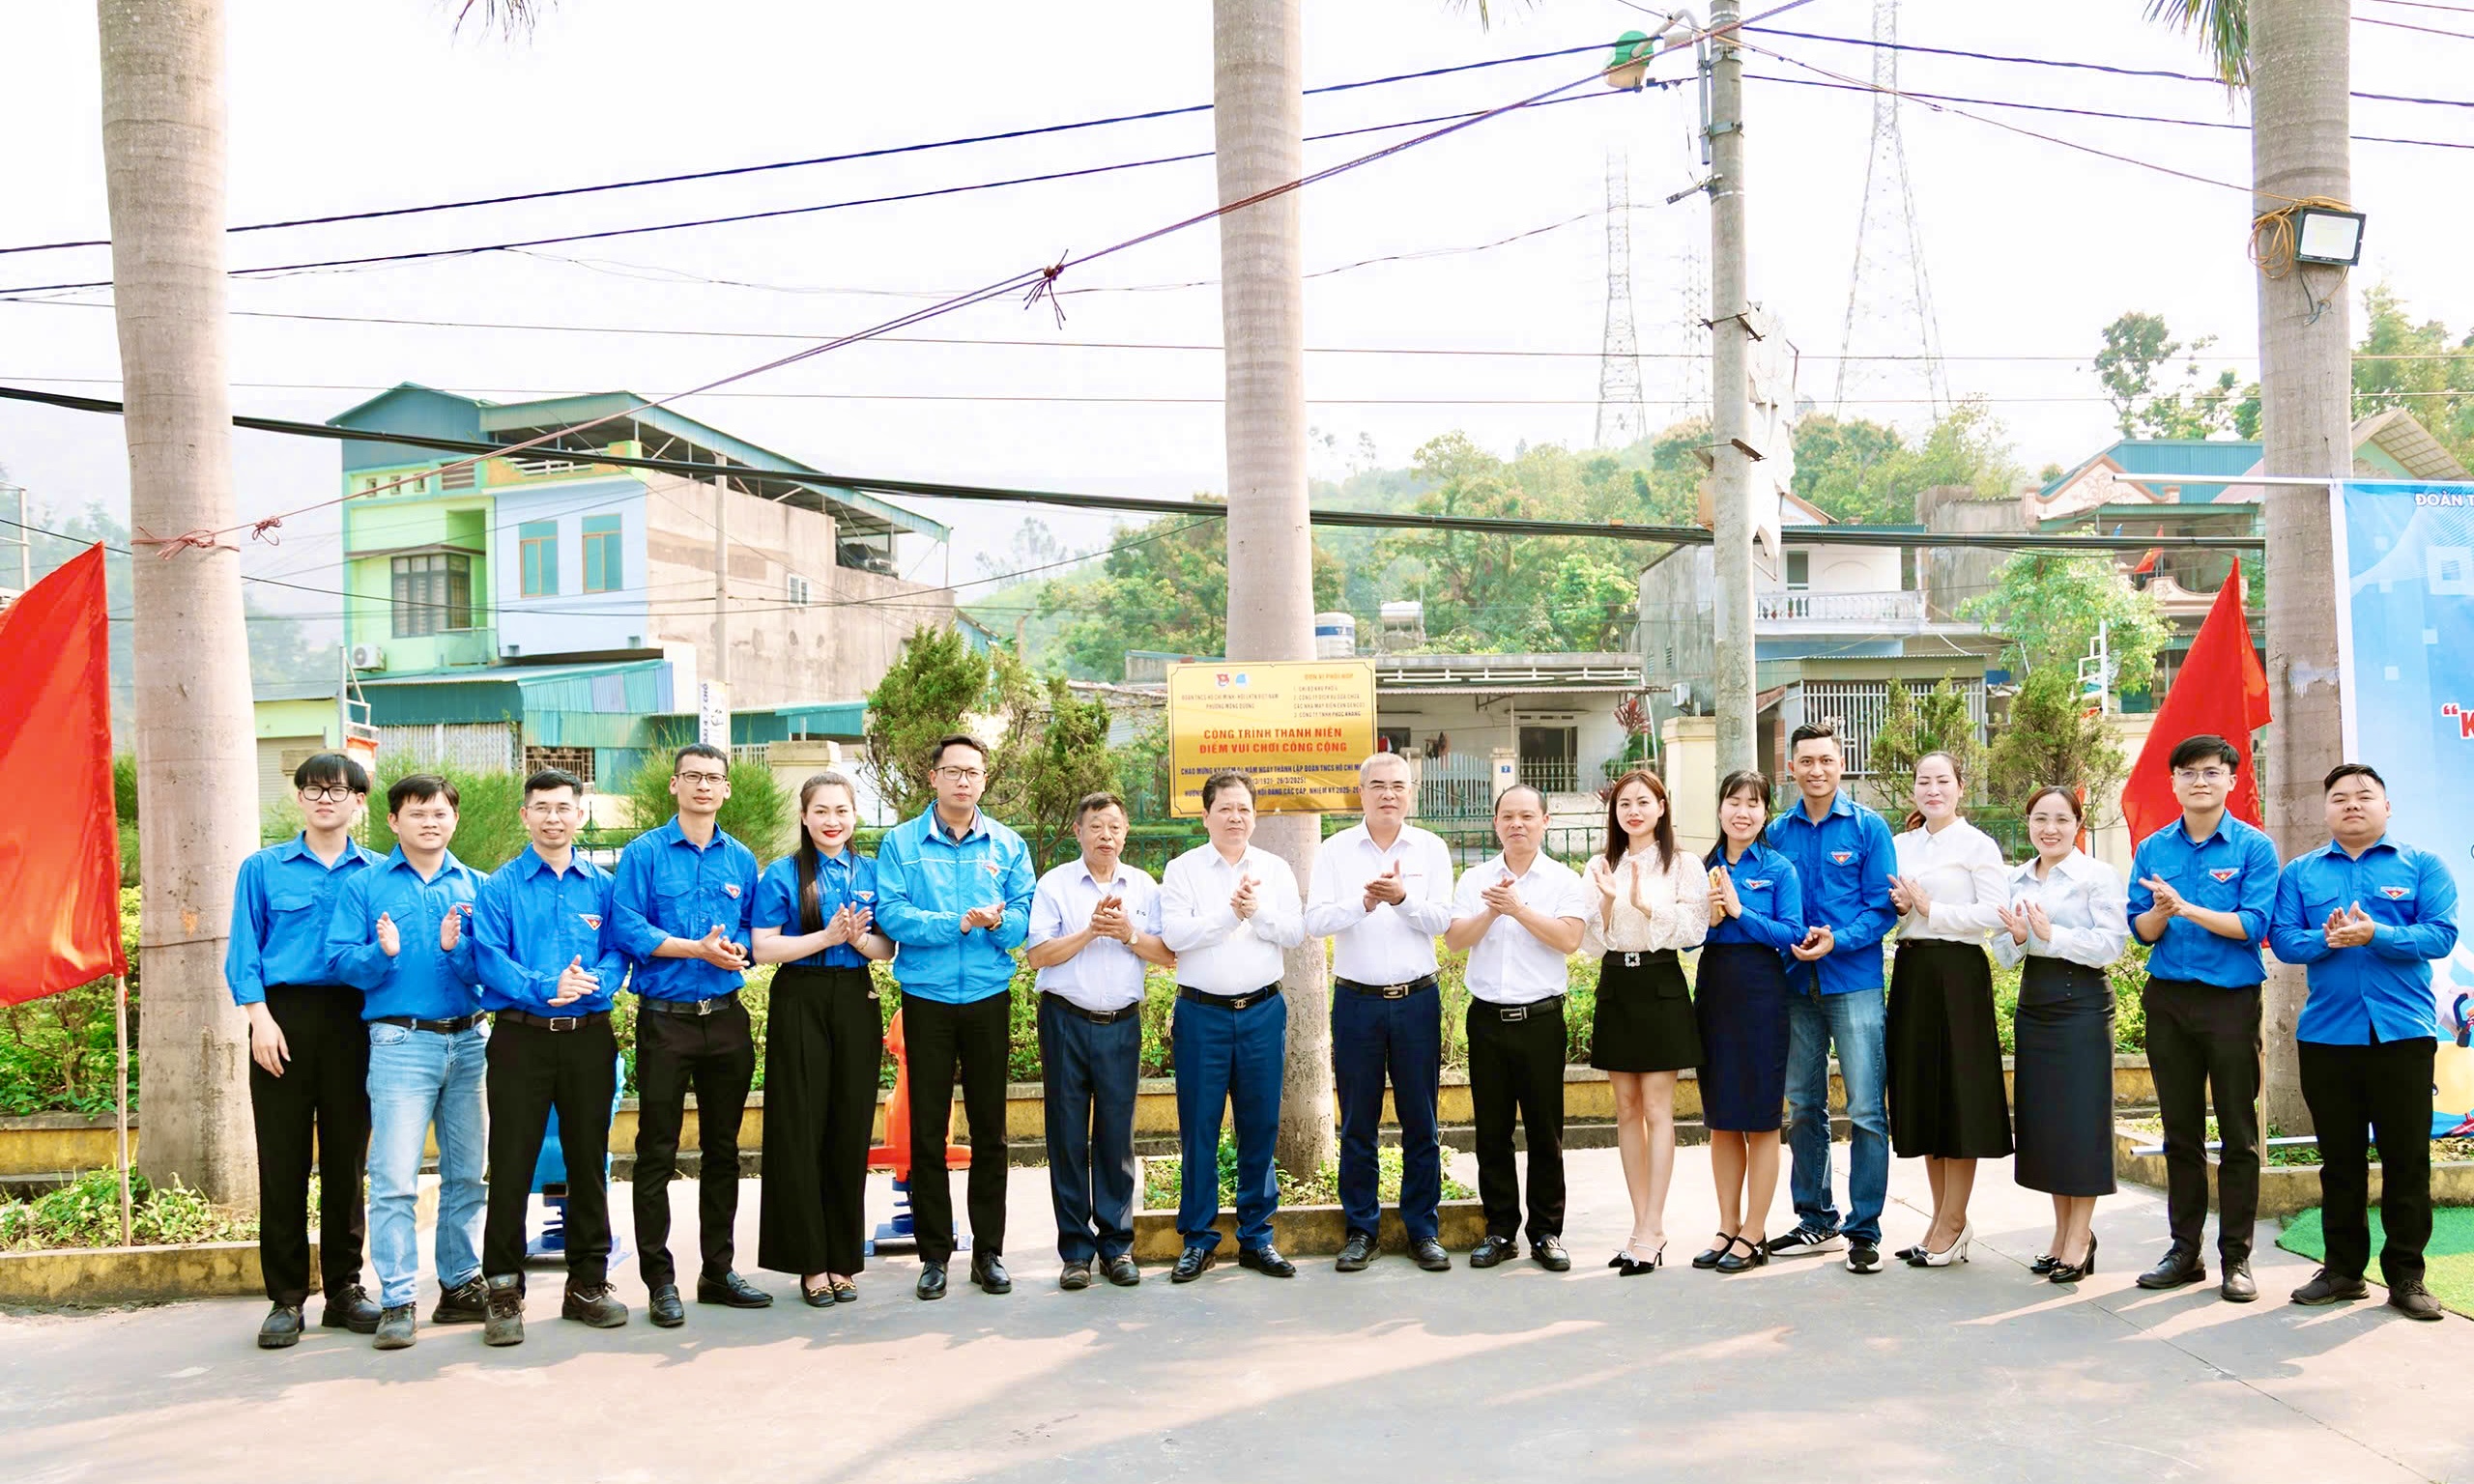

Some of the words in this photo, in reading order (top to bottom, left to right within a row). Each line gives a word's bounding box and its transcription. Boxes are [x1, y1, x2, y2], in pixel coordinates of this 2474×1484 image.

[2415, 490, 2463, 507] ĐOÀN
[1204, 728, 1235, 739] CÔNG
[1238, 727, 1271, 739] TRÌNH
[1275, 728, 1311, 738] THANH
[1315, 726, 1342, 738] NIÊN
[1231, 743, 1250, 754] VUI
[1252, 742, 1279, 753] CHƠI
[1282, 741, 1313, 753] CÔNG
[1316, 741, 1347, 754] CỘNG
